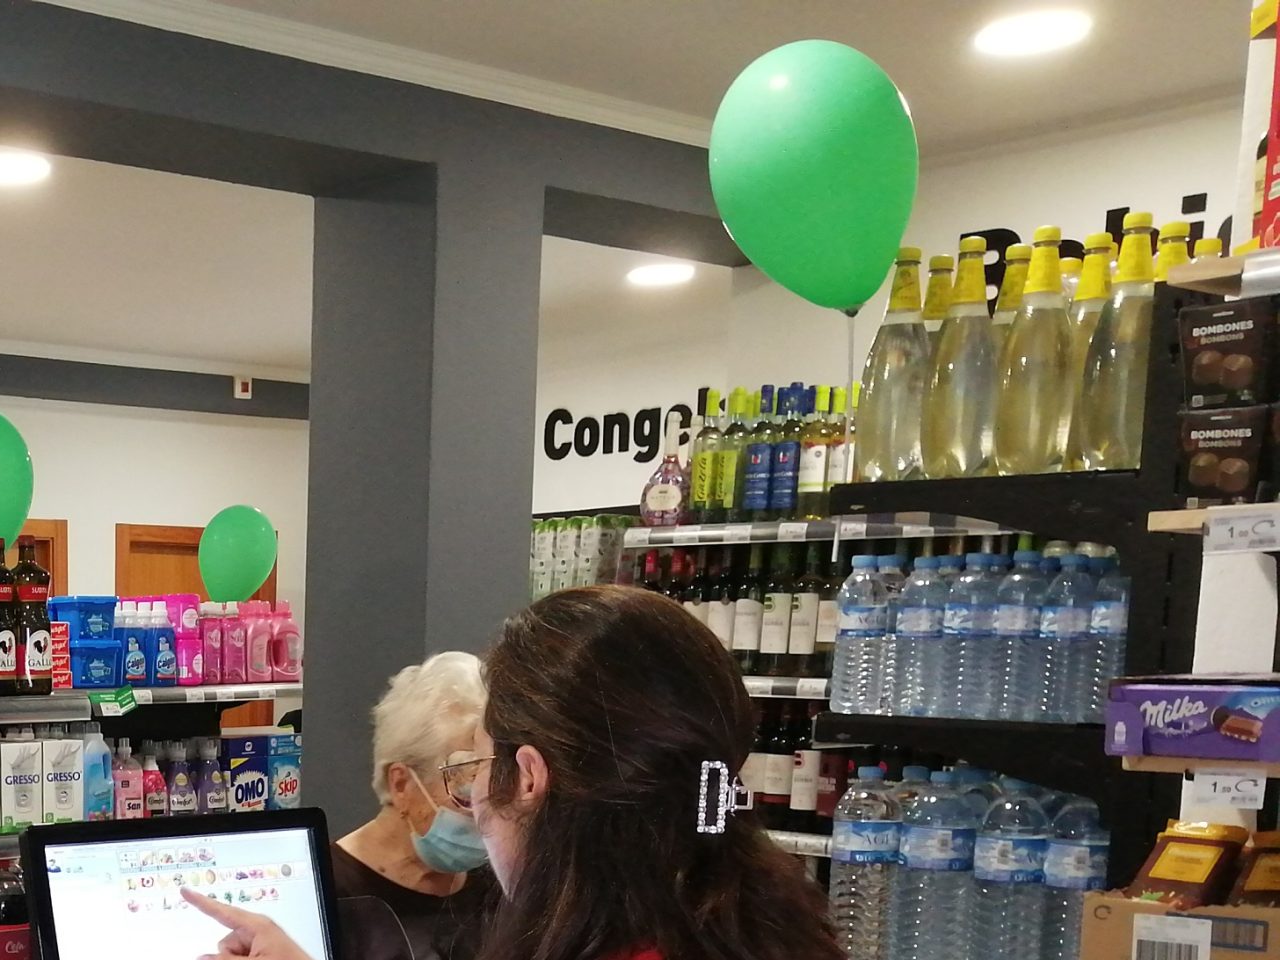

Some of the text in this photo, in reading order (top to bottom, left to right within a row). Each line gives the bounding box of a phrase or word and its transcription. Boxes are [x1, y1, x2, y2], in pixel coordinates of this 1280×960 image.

[1192, 320, 1254, 337] BOMBONES
[1190, 428, 1252, 440] BOMBONES
[1140, 696, 1208, 728] Milka
[4, 773, 40, 786] GRESSO
[46, 771, 81, 783] GRESSO
[235, 777, 265, 804] OMO
[277, 777, 298, 797] Skip
